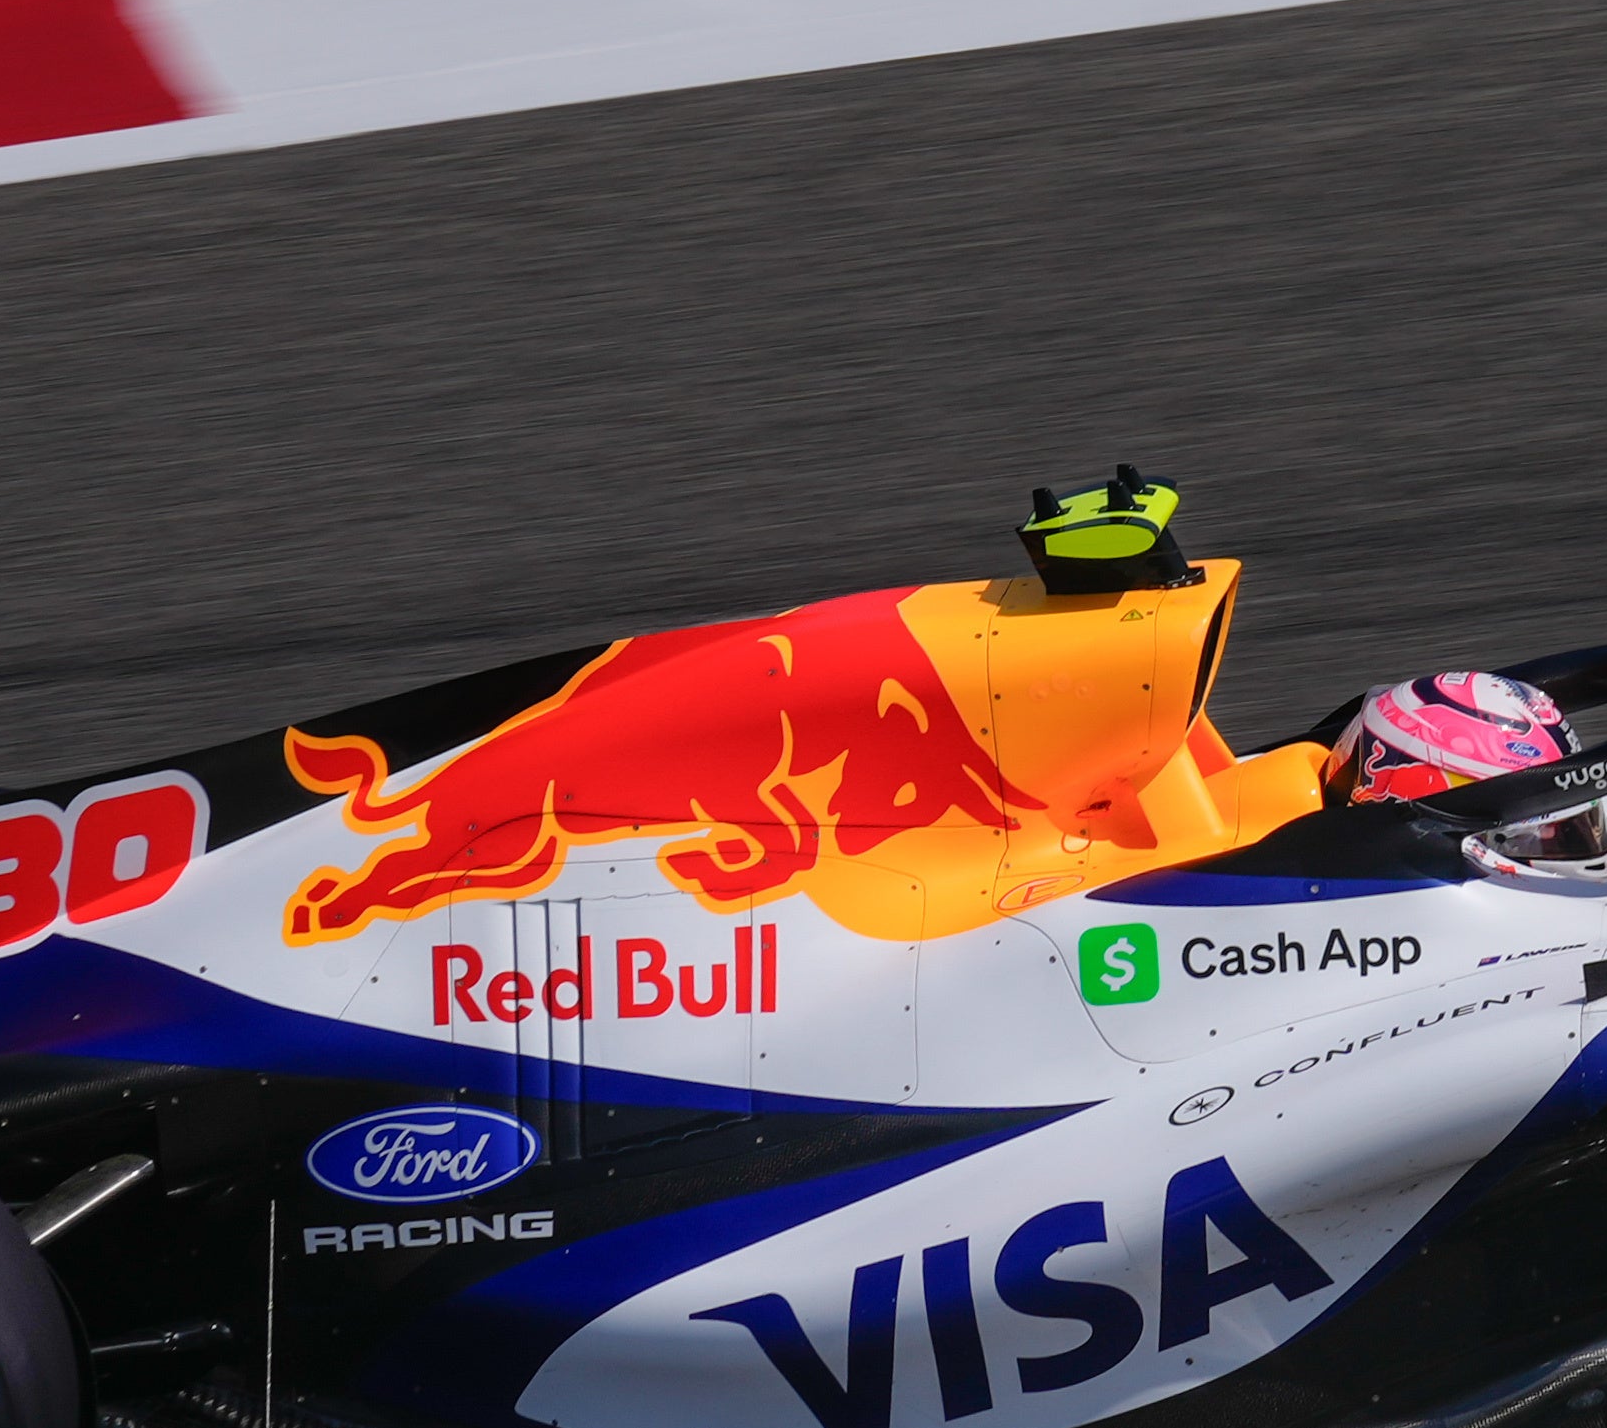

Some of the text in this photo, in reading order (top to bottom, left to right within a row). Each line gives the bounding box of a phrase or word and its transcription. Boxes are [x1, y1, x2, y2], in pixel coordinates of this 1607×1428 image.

[431, 923, 778, 1027] Red Bull
[1181, 930, 1306, 981] Cash
[1318, 928, 1422, 975] App
[1253, 985, 1546, 1088] CONFLUENT
[351, 1120, 496, 1188] Ford
[302, 1209, 556, 1255] RACING
